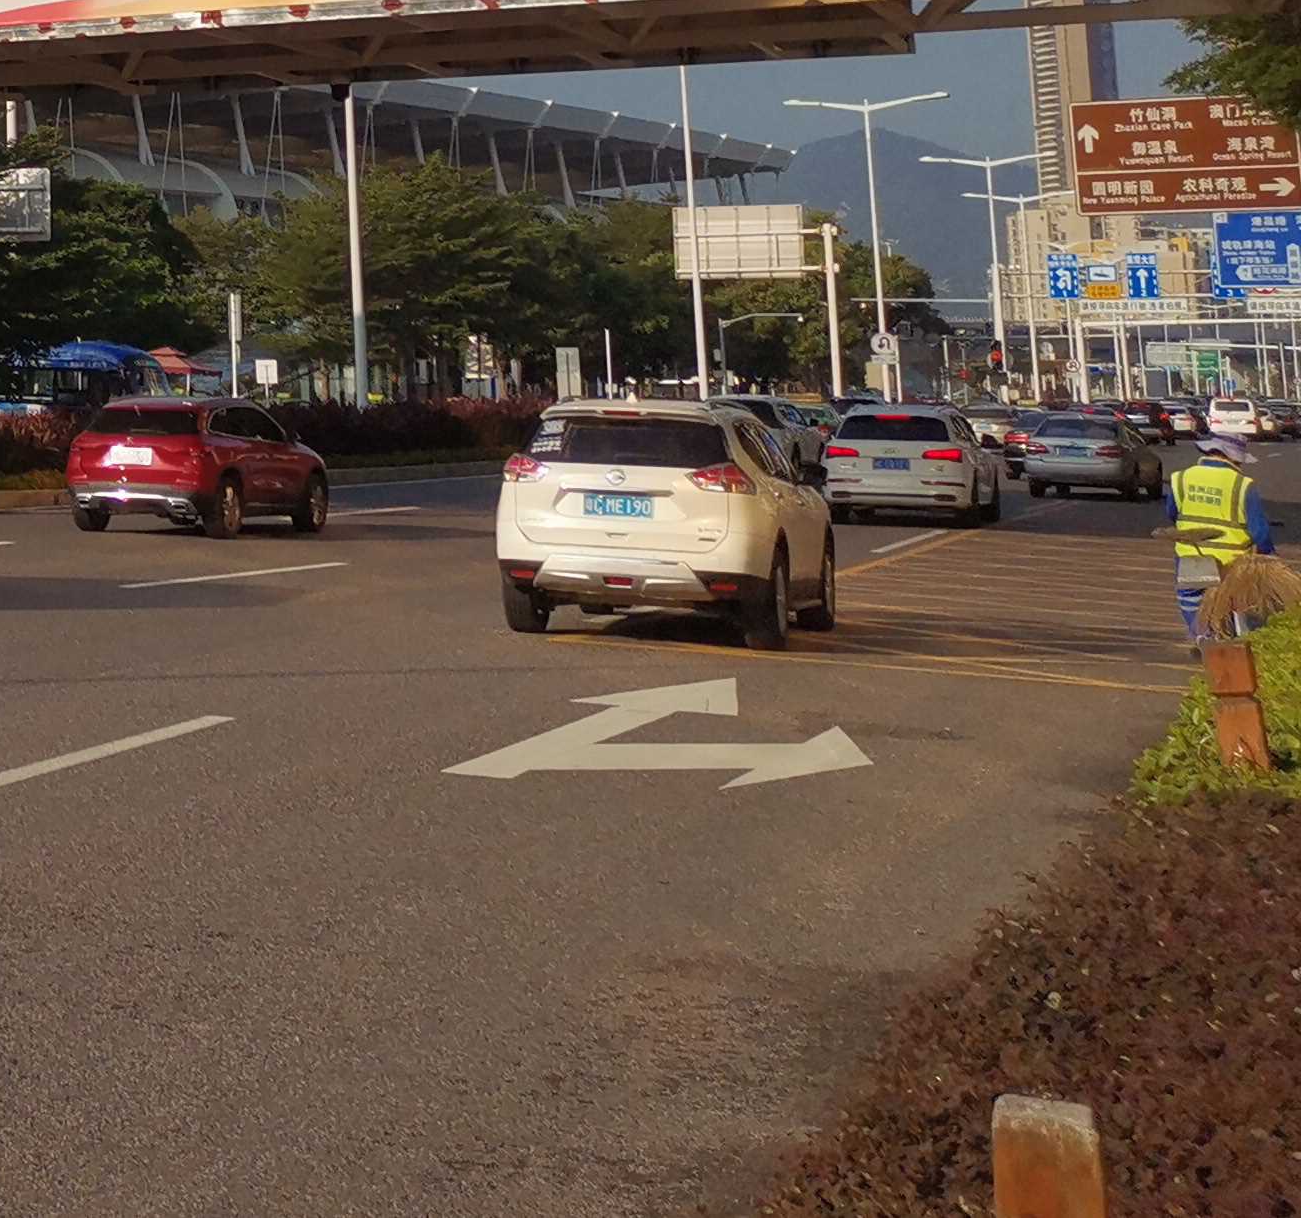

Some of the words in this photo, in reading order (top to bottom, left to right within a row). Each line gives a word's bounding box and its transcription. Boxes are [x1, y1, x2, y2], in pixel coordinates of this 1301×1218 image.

[1129, 106, 1177, 123] 竹仙洞
[1173, 120, 1194, 129] Park
[1182, 177, 1247, 192] 农科奇观
